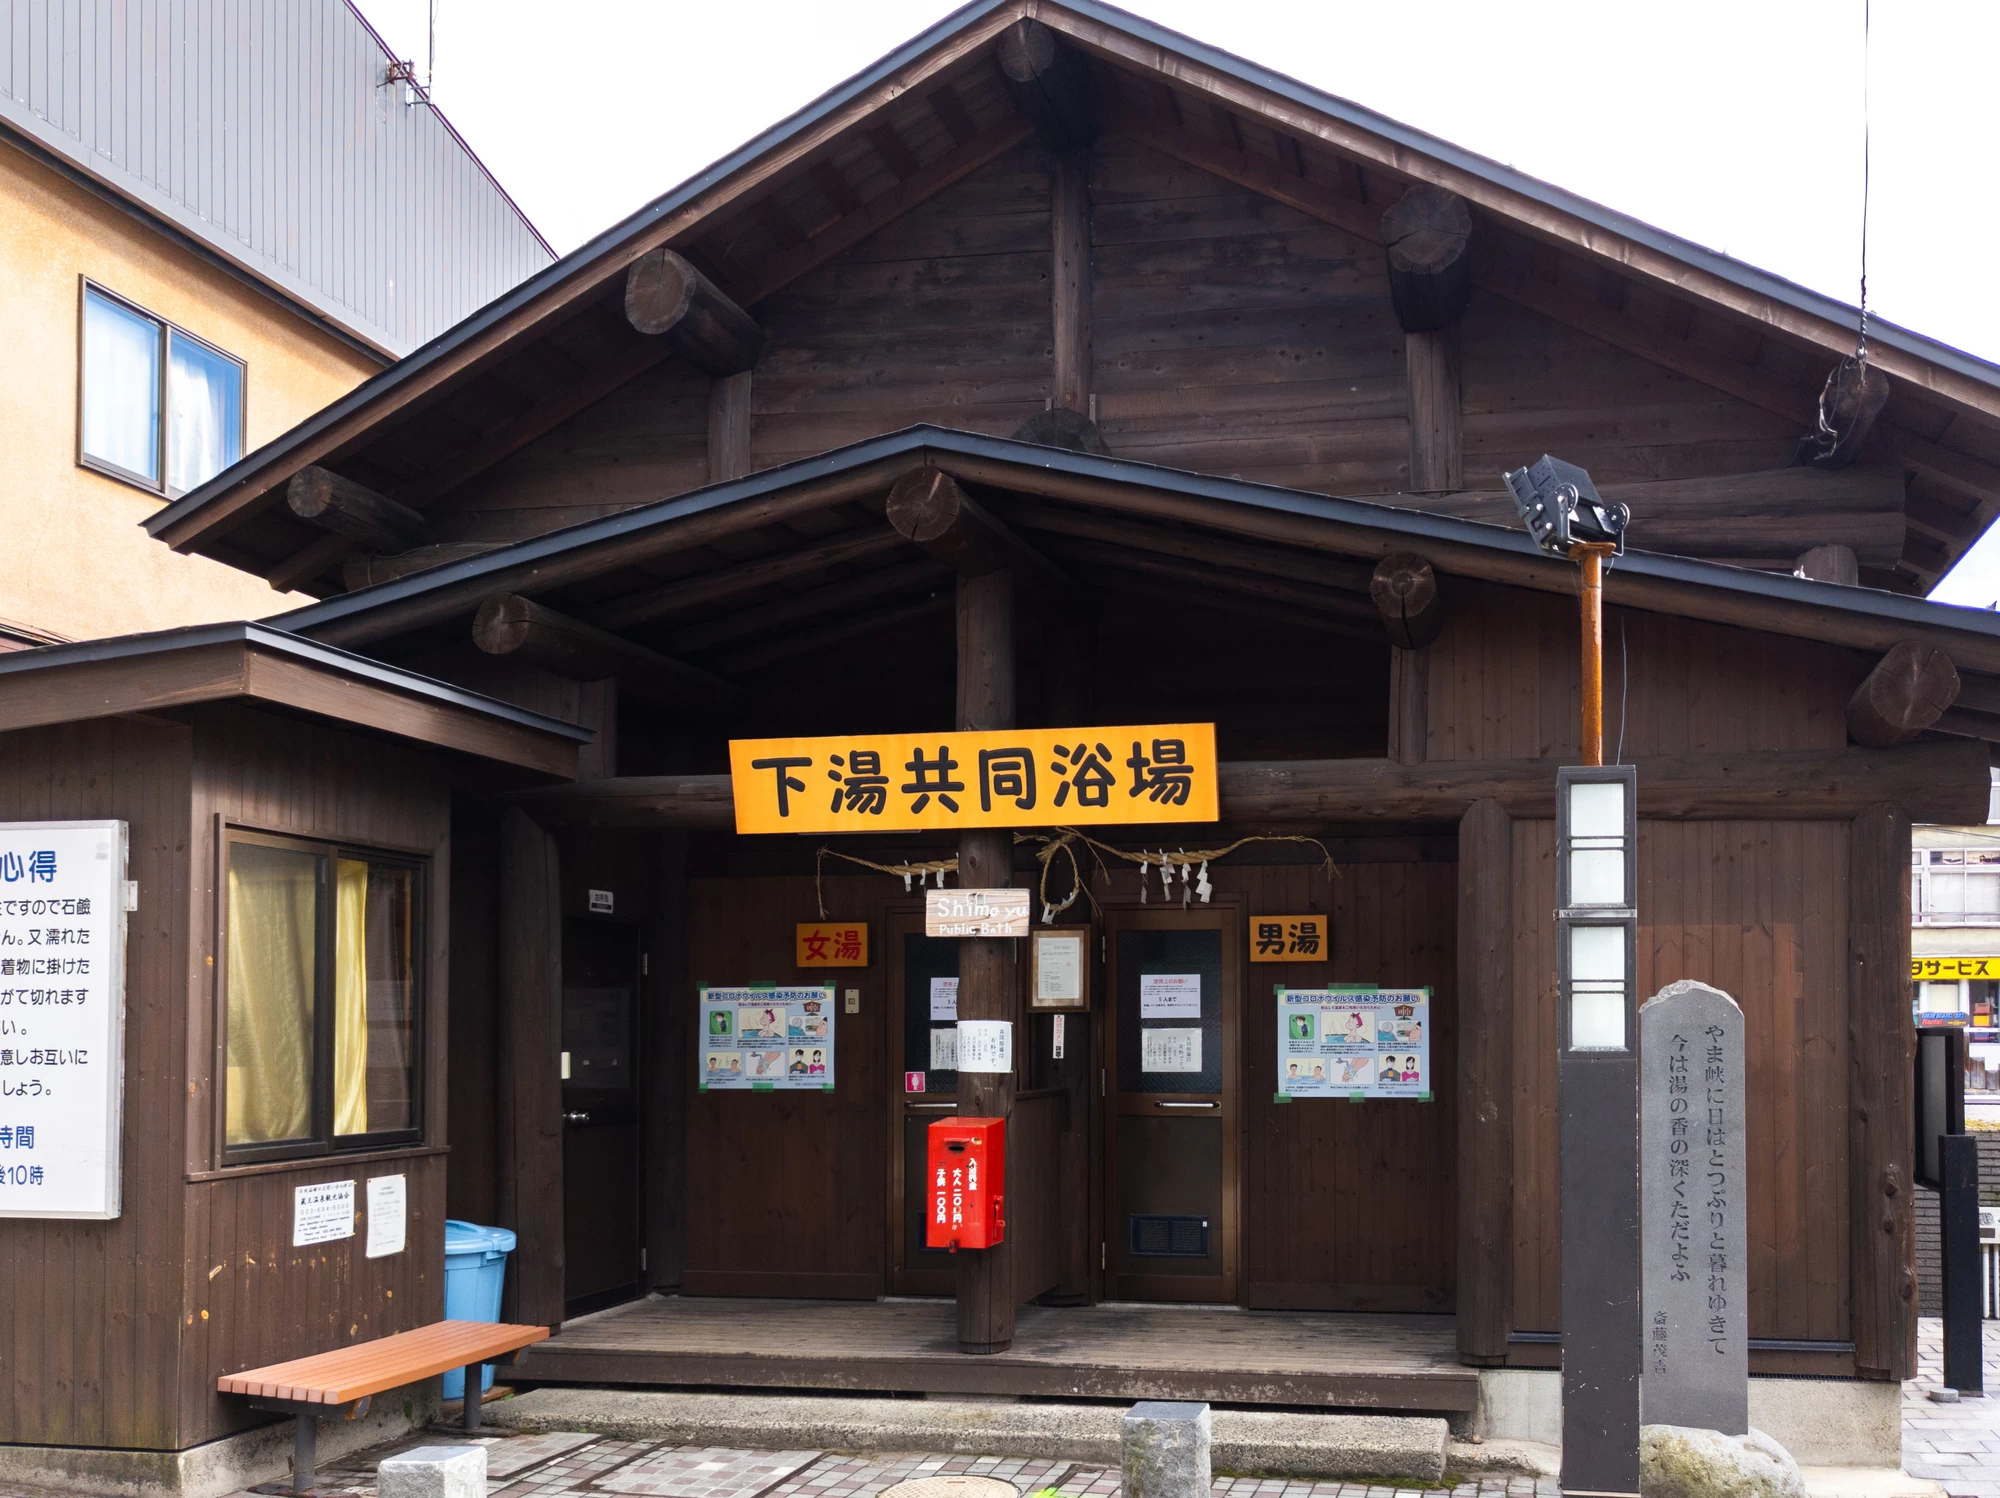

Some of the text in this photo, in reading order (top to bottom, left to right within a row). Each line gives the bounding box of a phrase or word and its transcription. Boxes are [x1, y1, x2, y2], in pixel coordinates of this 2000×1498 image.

[751, 738, 1194, 819] 下湯共同浴場
[0, 850, 57, 883] 心得
[939, 922, 1012, 935] Public Bath
[802, 929, 863, 961] 女湯
[1255, 922, 1320, 956] 男湯
[1, 958, 90, 976] 着物に掛けた
[0, 988, 89, 1005] がて切れます
[707, 991, 827, 1000] 新型コロナウイルス感染予防のお願い
[1286, 993, 1421, 1004] 新型コロナウイルス感染予防のお願い
[1, 1048, 88, 1065] 意しお互いに
[3, 1079, 51, 1096] しょう。
[0, 1125, 34, 1149] 時間
[1669, 1034, 1690, 1282] 今は湯の香の深くただよふ
